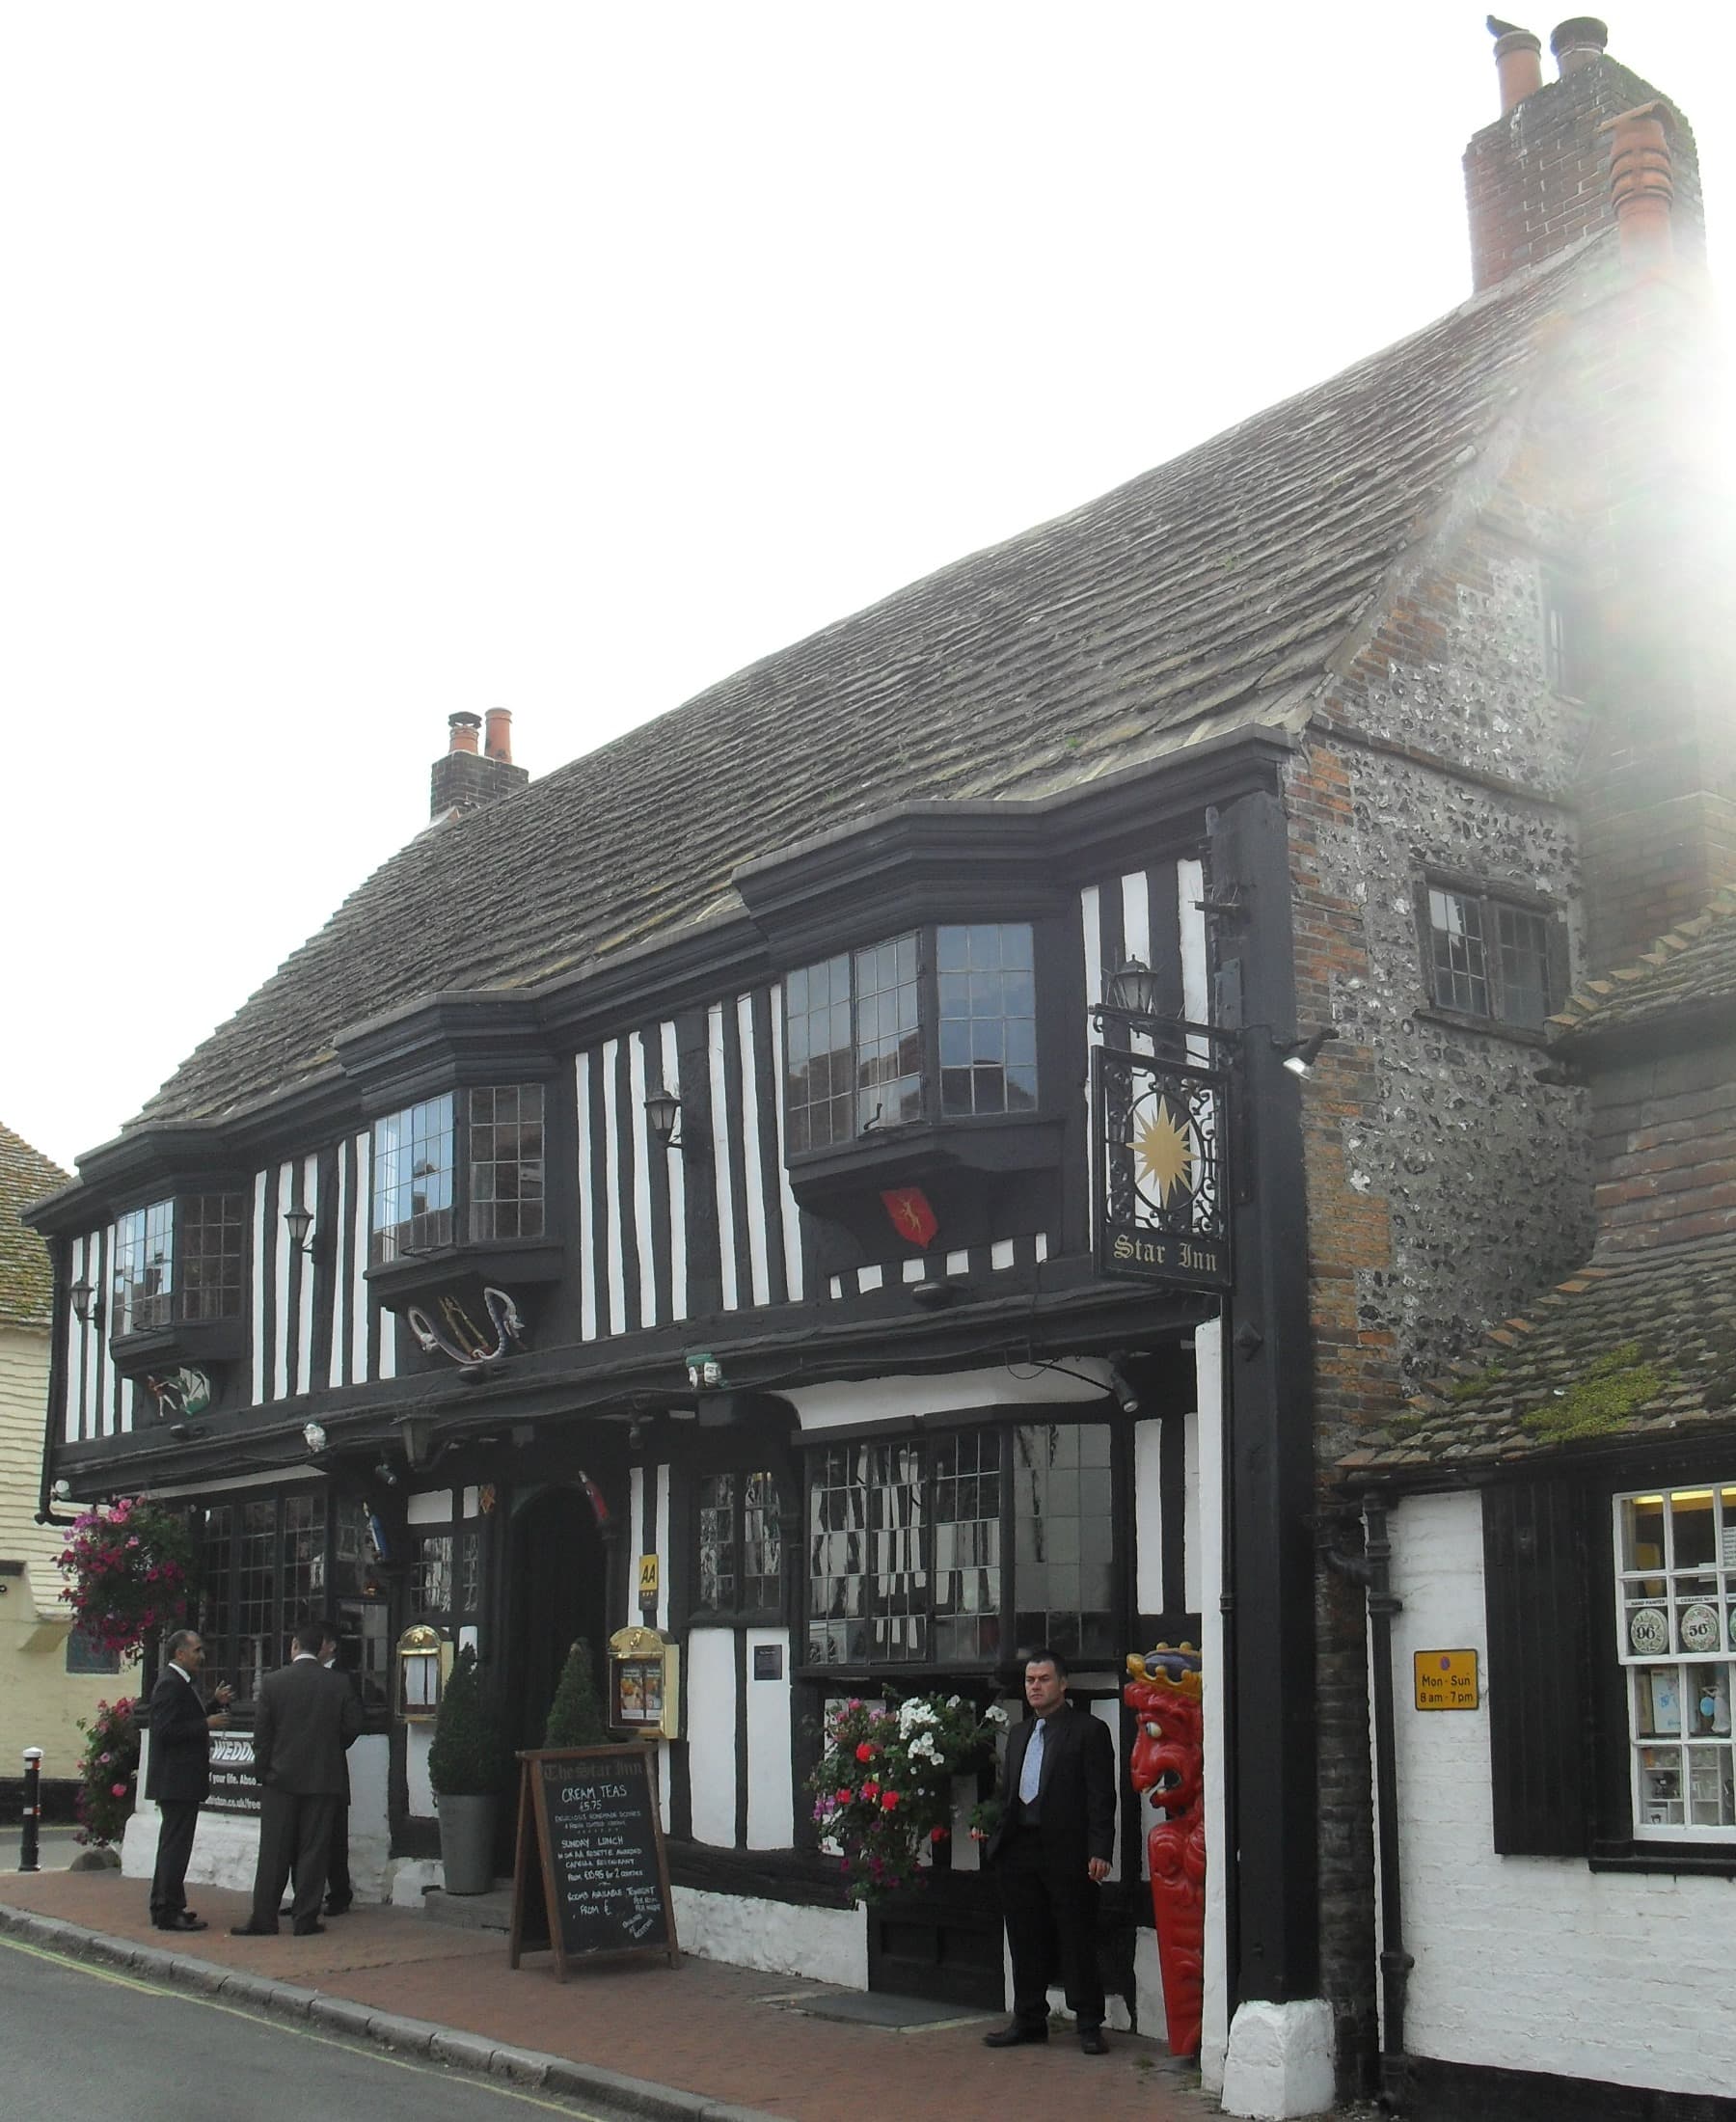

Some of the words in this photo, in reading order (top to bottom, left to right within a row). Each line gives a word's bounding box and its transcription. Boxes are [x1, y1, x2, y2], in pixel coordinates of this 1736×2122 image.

[1113, 1235, 1165, 1264] Star
[1179, 1242, 1216, 1271] Inn
[640, 1564, 656, 1584] AA
[1637, 1626, 1655, 1639] 96
[1689, 1623, 1708, 1637] 56
[1422, 1674, 1443, 1687] Mon
[1451, 1675, 1471, 1686] Sun
[544, 1763, 574, 1782] The
[576, 1761, 611, 1779] Star
[614, 1758, 643, 1776] Inn
[561, 1786, 596, 1803] CREAM
[600, 1783, 628, 1798] TEAS
[561, 1837, 590, 1848] SUNDAY
[598, 1836, 624, 1846] LUNCH
[580, 1904, 600, 1915] FROM
